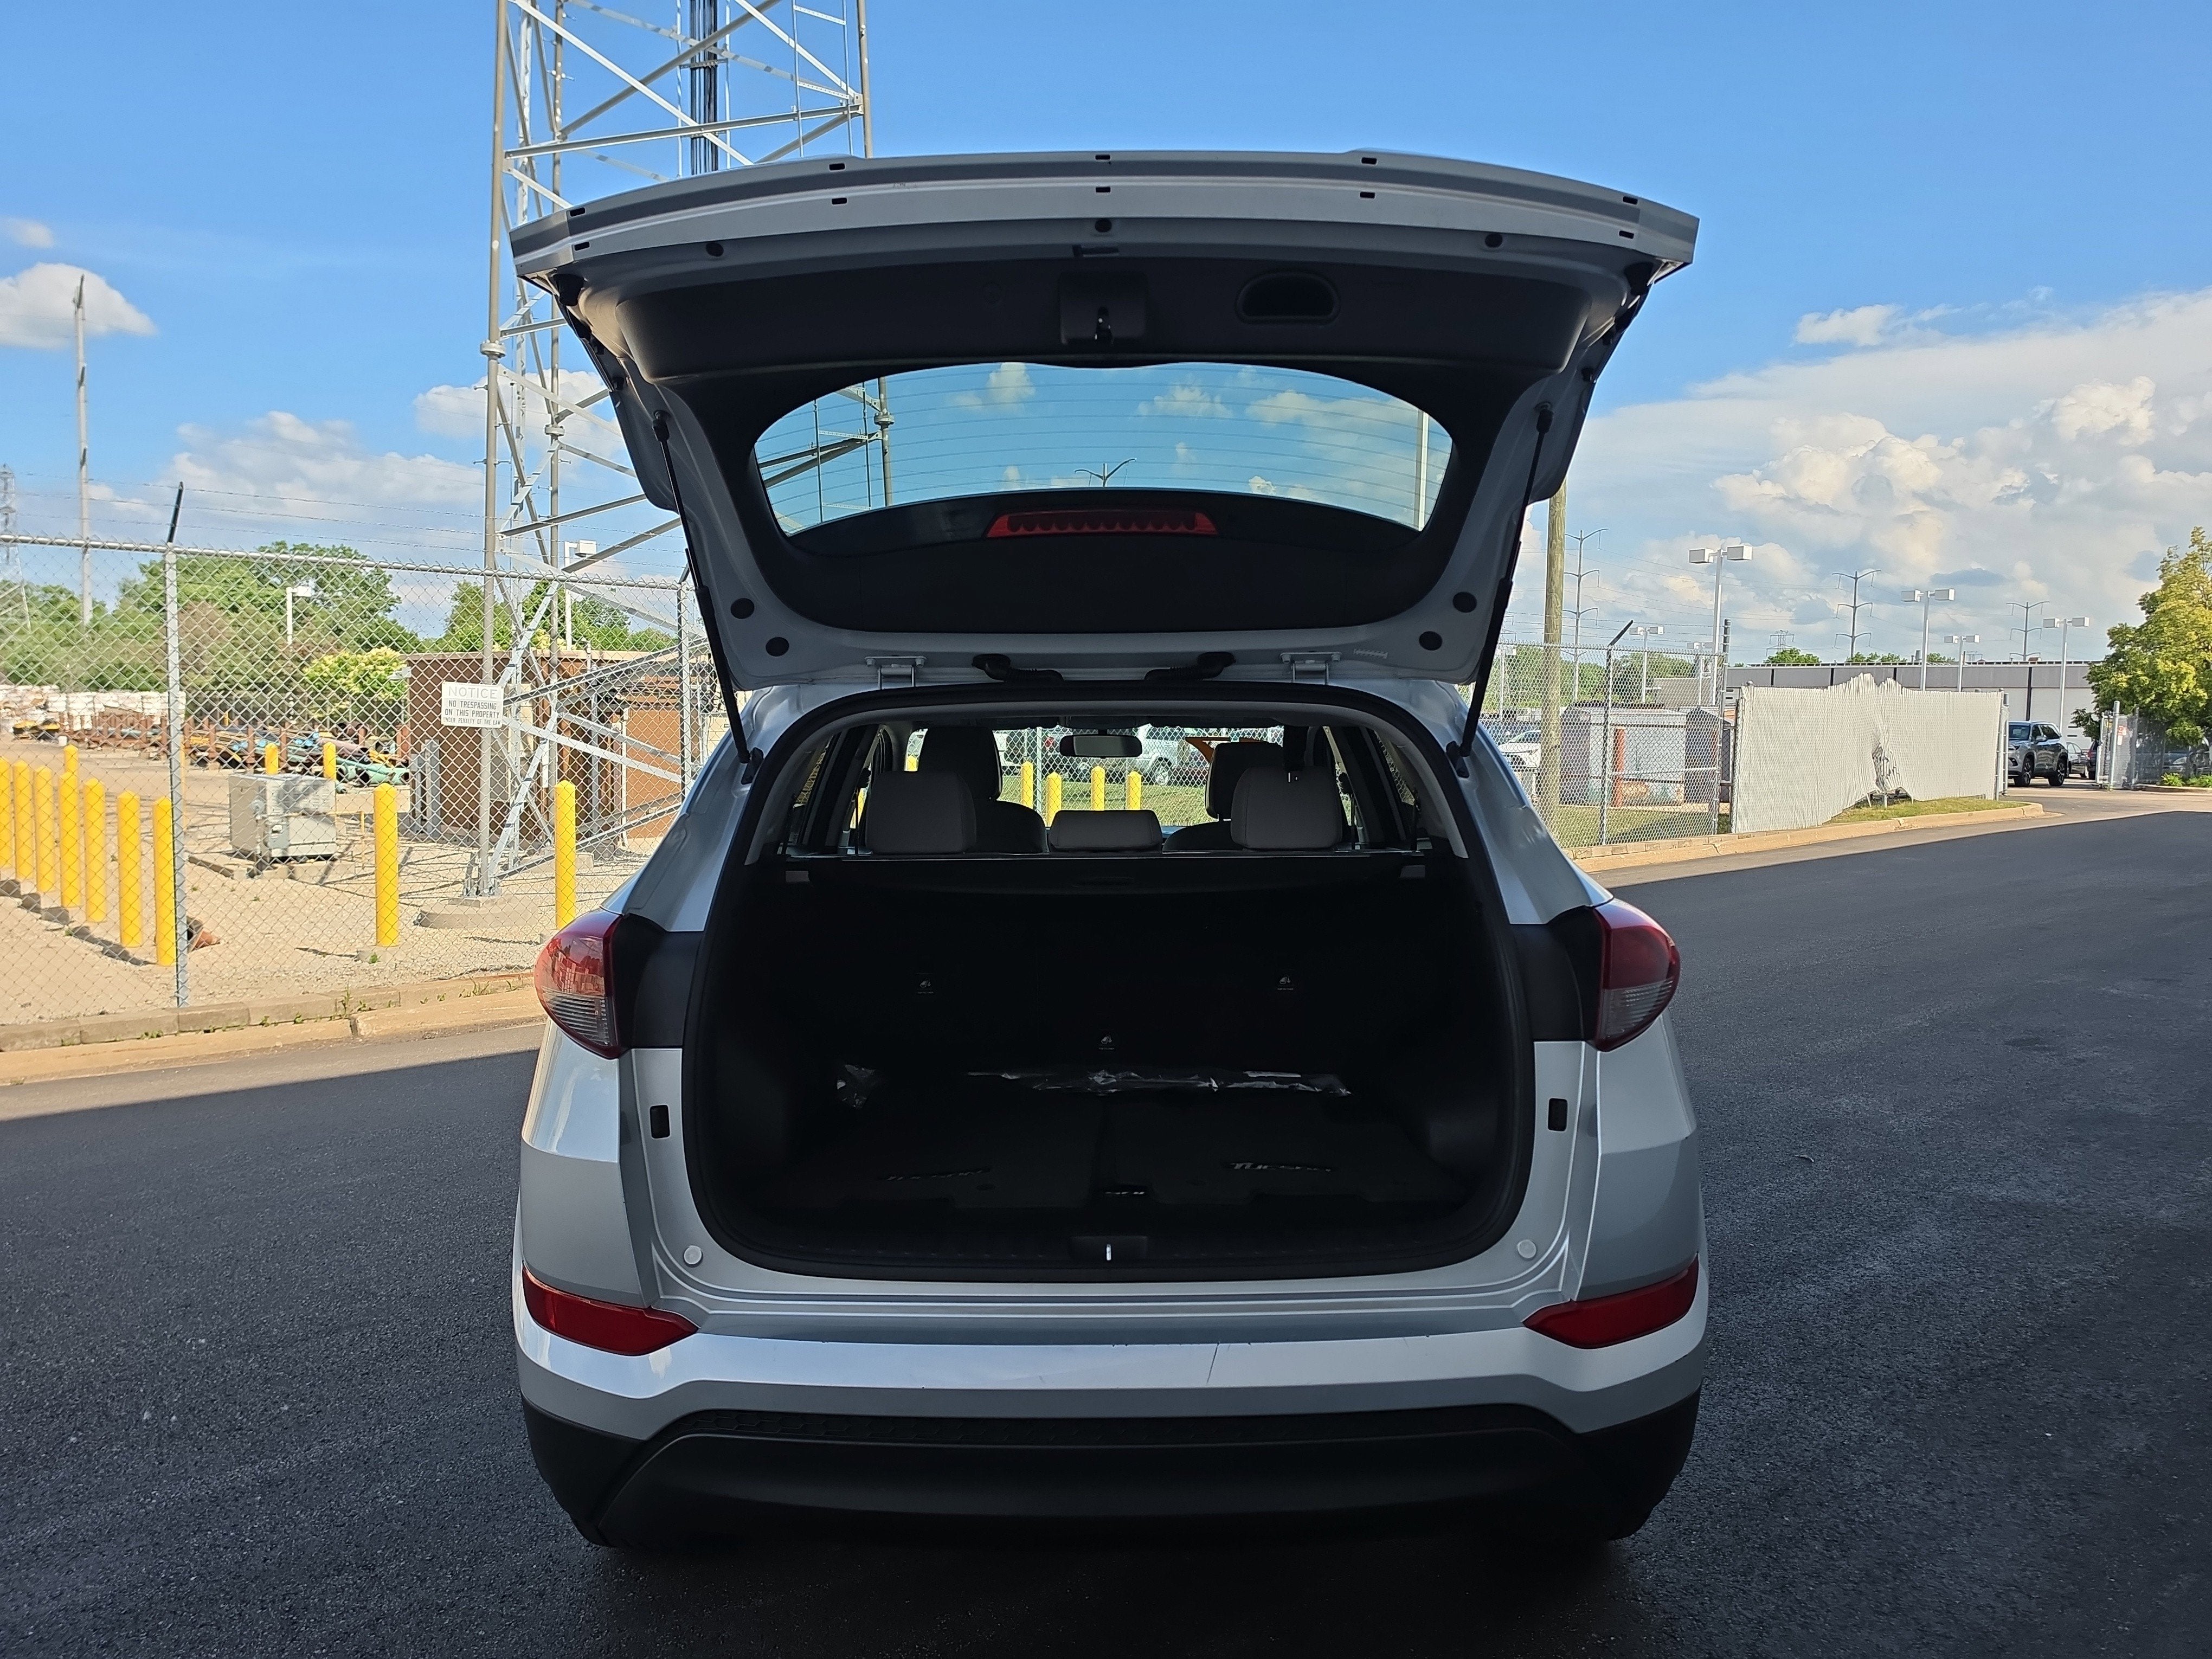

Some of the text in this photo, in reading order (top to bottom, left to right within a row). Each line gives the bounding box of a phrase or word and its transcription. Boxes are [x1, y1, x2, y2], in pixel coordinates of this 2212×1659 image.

[448, 686, 498, 699] NOTICE
[460, 701, 497, 710] TRESPASSING
[472, 710, 500, 718] PROPERTY
